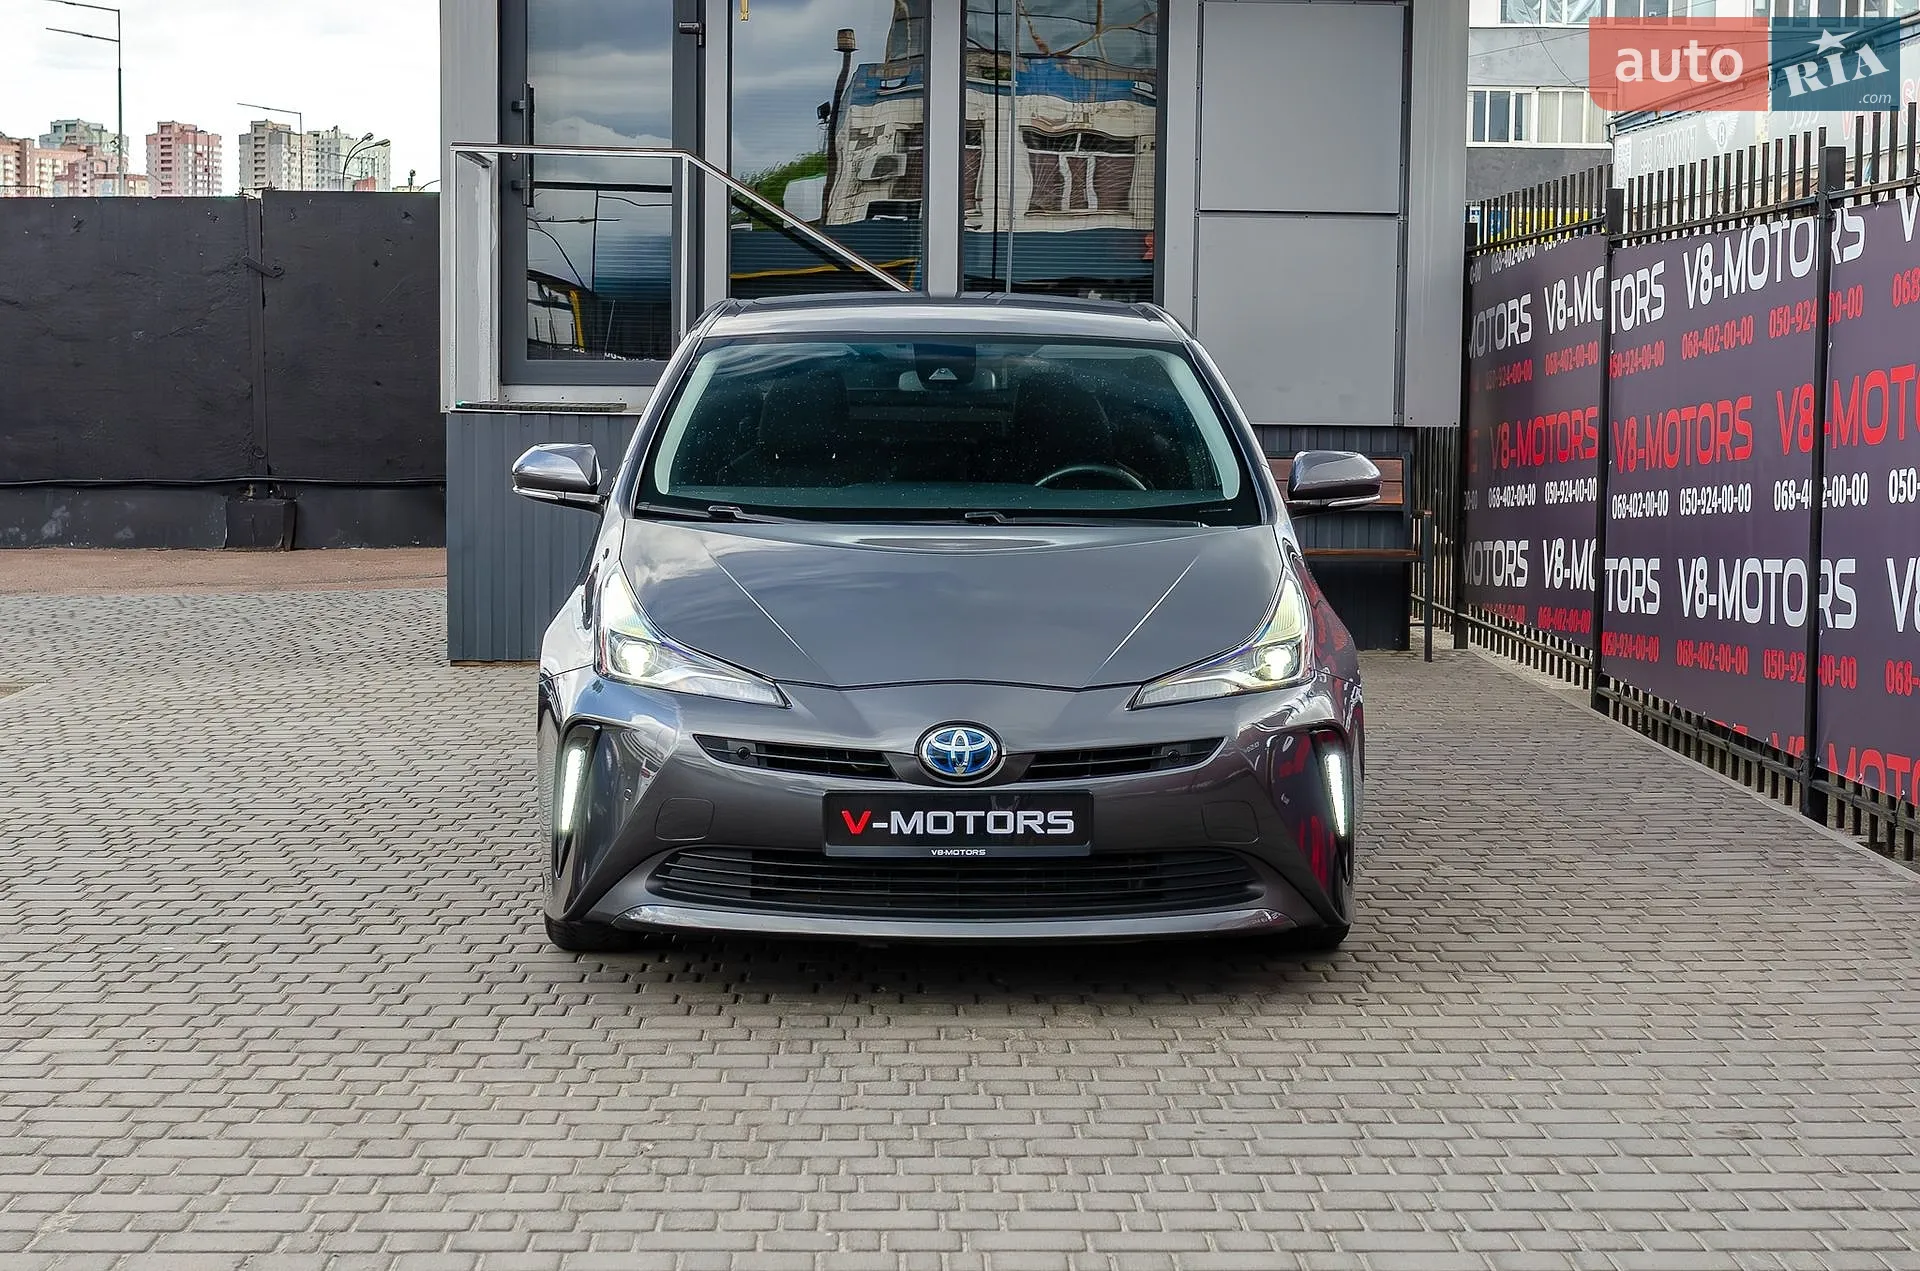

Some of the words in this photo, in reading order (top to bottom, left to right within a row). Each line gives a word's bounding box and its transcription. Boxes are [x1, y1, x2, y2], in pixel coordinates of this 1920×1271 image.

[1682, 315, 1753, 360] 068-402-00-00
[1613, 396, 1753, 474] V8-MOTORS
[1776, 364, 1920, 456] V8-MOT
[1488, 483, 1536, 508] 068-402-00-00
[1545, 477, 1598, 504] 050-924-00-00
[1612, 490, 1669, 519] 068-402-00-00
[1680, 483, 1752, 516] 050-924-00-00
[1676, 639, 1749, 676] 068-402-00-00
[841, 810, 1075, 835] V-MOTORS
